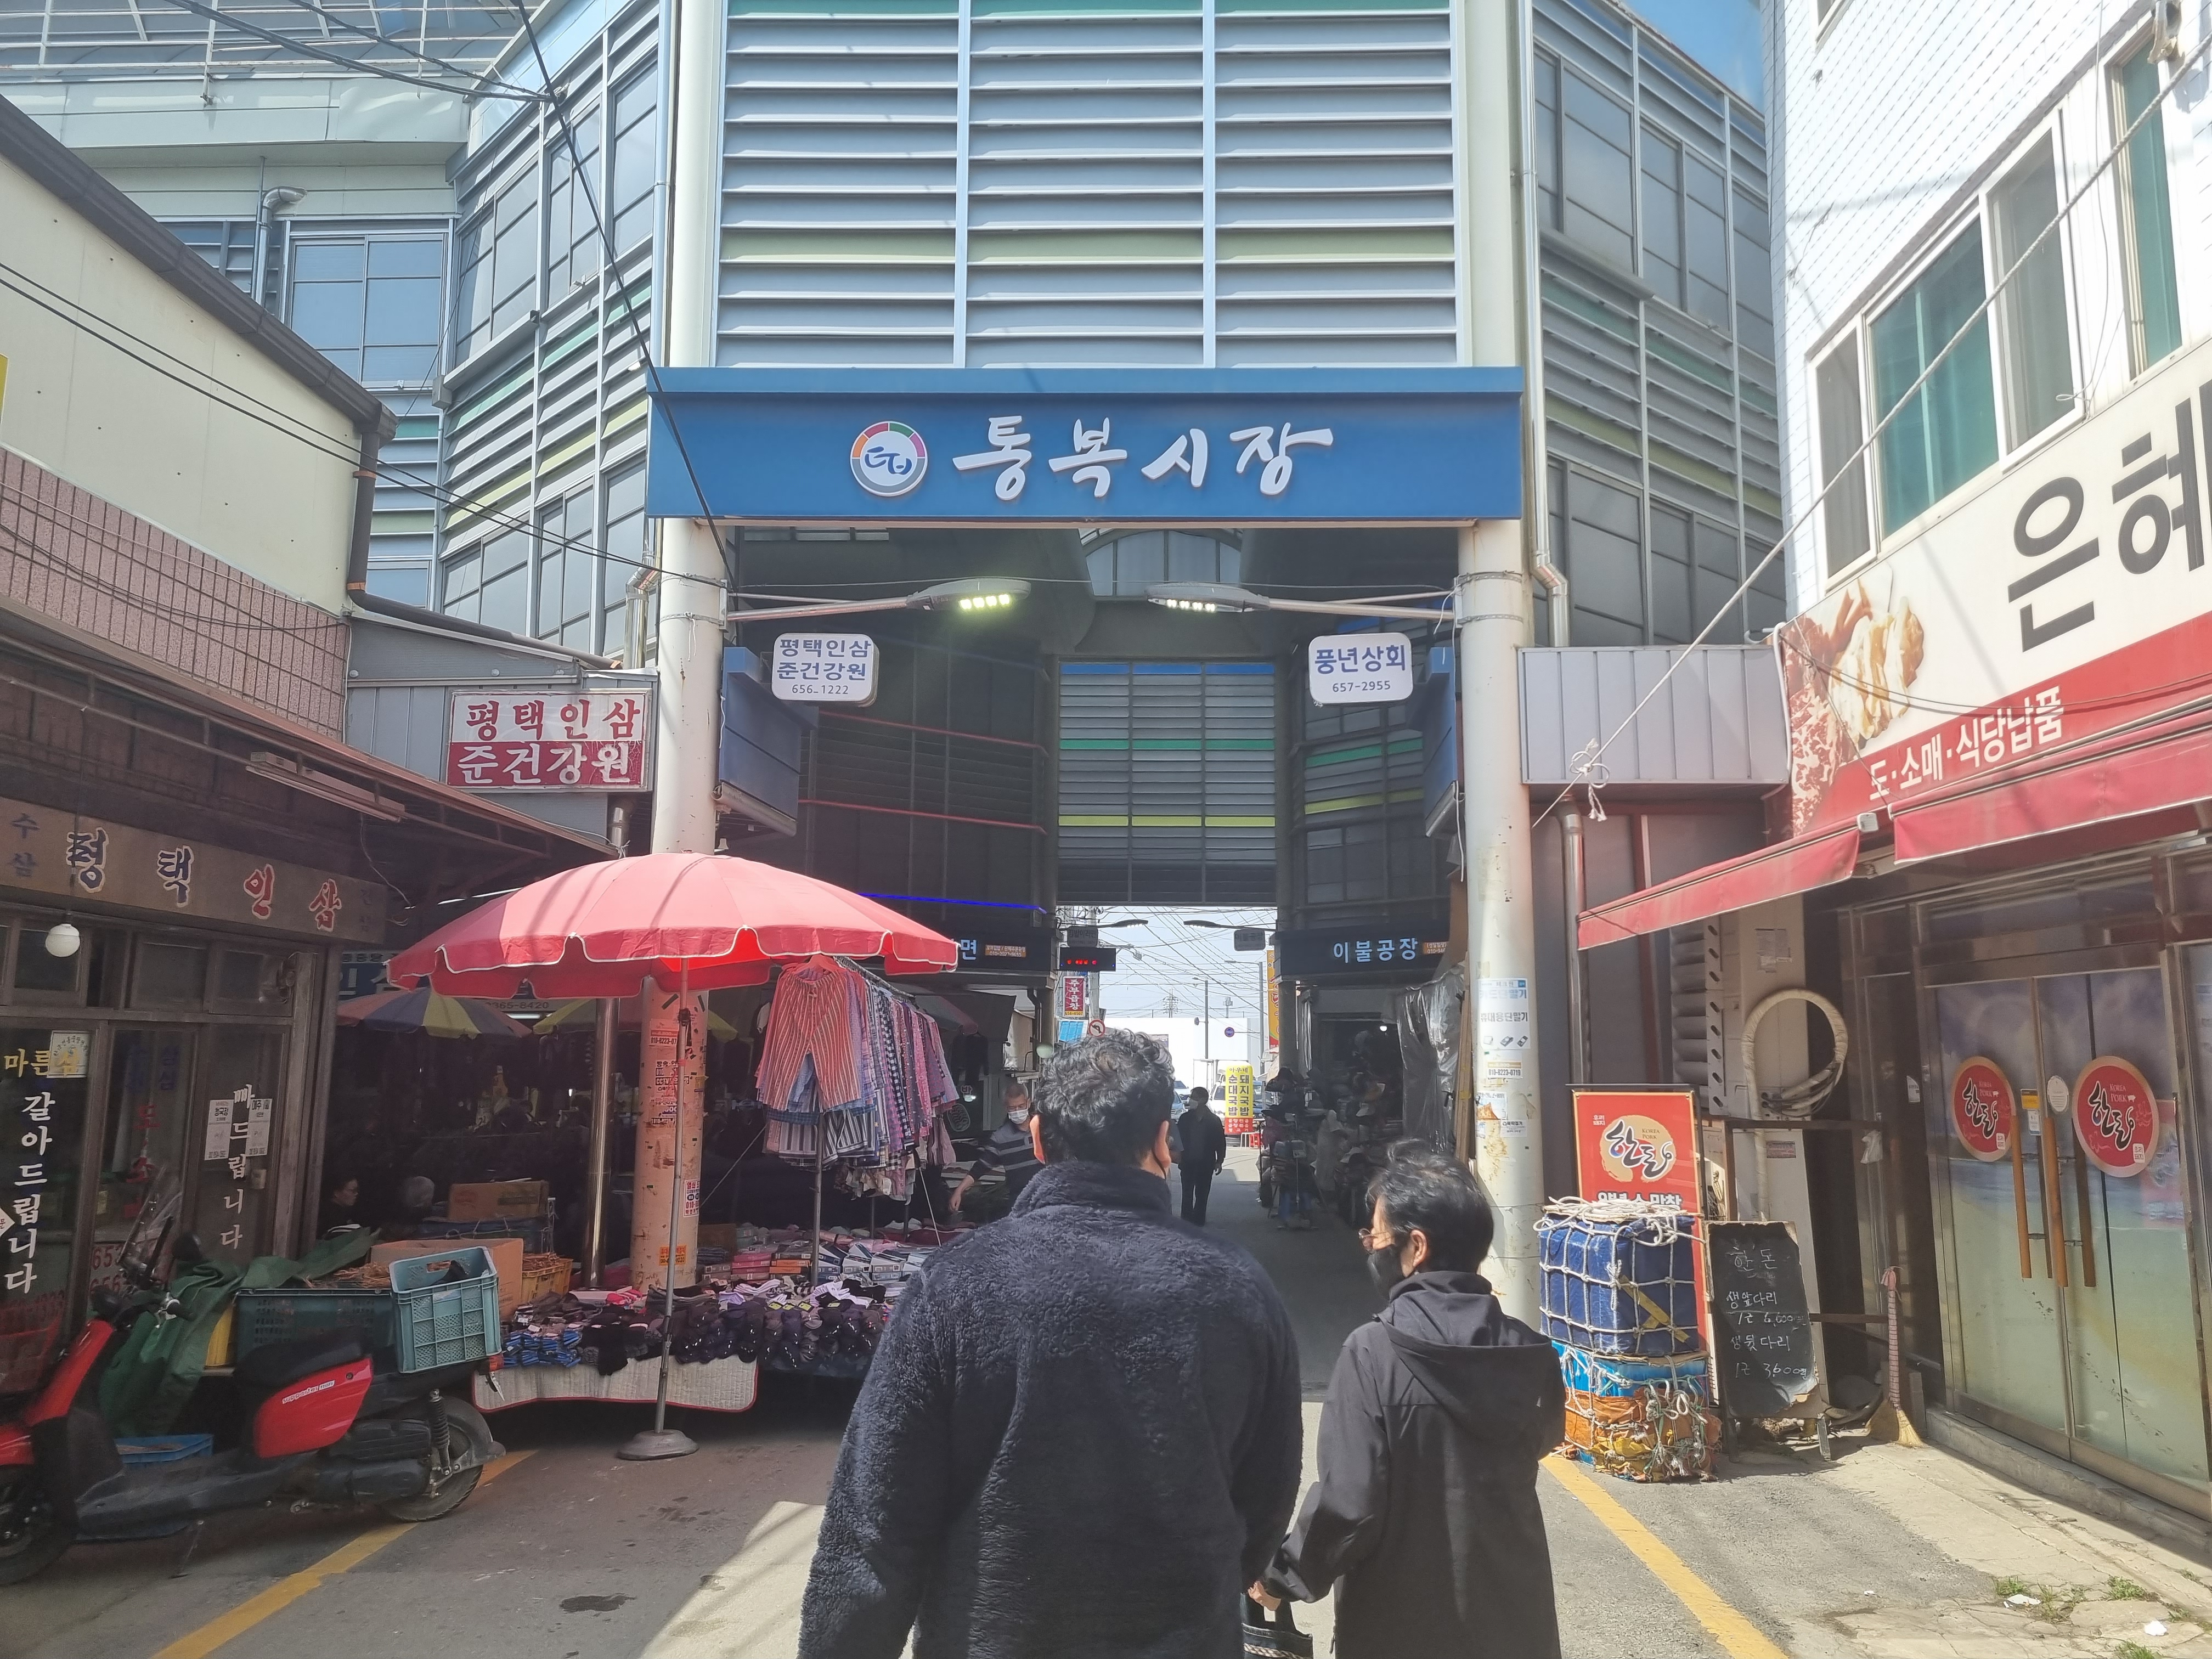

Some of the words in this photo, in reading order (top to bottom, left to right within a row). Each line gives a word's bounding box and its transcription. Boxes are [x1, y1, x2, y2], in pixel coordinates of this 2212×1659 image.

[952, 415, 1333, 500] 통복시장
[780, 639, 872, 658] 평택인삼
[1314, 644, 1406, 675] 풍년상회
[776, 662, 866, 681] 준건강원
[792, 684, 849, 695] 656-1222
[1332, 680, 1391, 692] 657-2955
[466, 699, 640, 741] 평택인삼
[457, 742, 630, 784] 준건강원
[1333, 937, 1418, 963] 이불공장
[1069, 979, 1080, 1011] 주부곱창
[1481, 1012, 1528, 1022] 휴대용단말기
[1228, 1074, 1238, 1116] 순대국밥
[1239, 1074, 1250, 1116] 돼지국밥
[2109, 1084, 2126, 1092] KOREA
[2111, 1093, 2128, 1102] PORK
